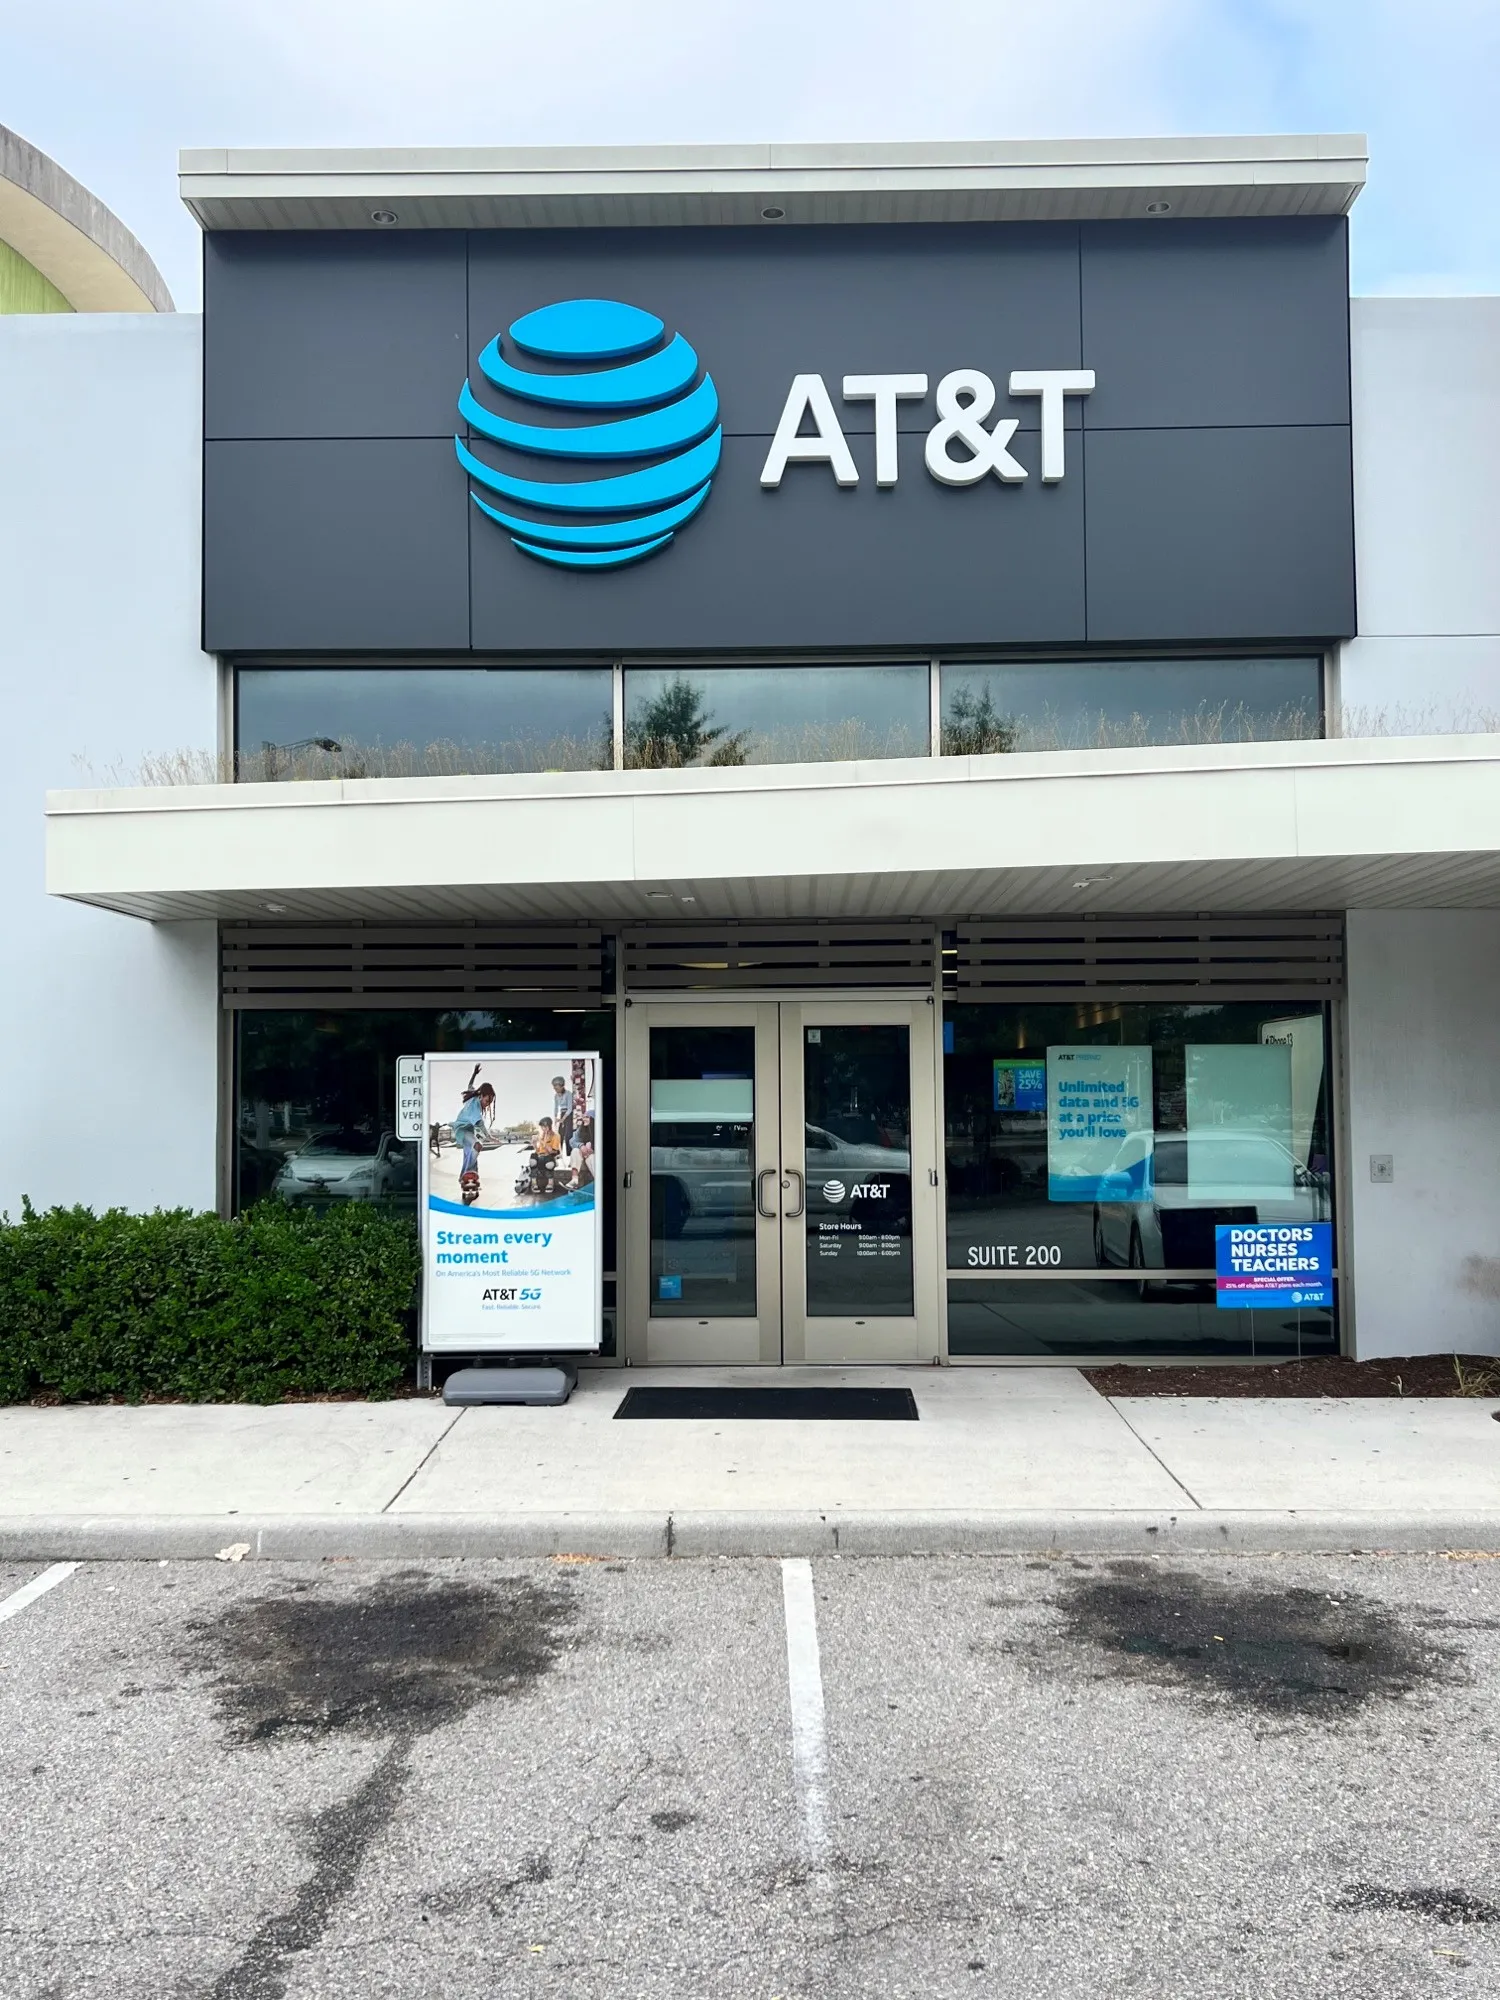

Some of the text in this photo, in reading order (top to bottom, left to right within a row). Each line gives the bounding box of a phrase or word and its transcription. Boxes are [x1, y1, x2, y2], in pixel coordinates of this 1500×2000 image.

[758, 368, 1096, 488] AT&T
[401, 1075, 423, 1084] EMIT
[1018, 1069, 1042, 1079] SAVE
[1018, 1078, 1043, 1090] 25%
[1058, 1081, 1125, 1093] Unlimited
[401, 1099, 423, 1108] EFFI
[1058, 1096, 1139, 1108] data and 5G
[1059, 1111, 1121, 1126] at a price
[1059, 1126, 1127, 1140] you'll love
[850, 1184, 890, 1199] AT&T
[819, 1222, 862, 1230] Store Hours
[436, 1230, 553, 1247] Stream every
[1230, 1228, 1313, 1243] DOCTORS
[436, 1249, 509, 1264] moment
[967, 1245, 1061, 1266] SUITE 200
[1231, 1243, 1298, 1257] NURSES
[1231, 1257, 1320, 1272] TEACHERS
[482, 1288, 542, 1301] AT&T 5G
[1304, 1293, 1324, 1301] AT&T
